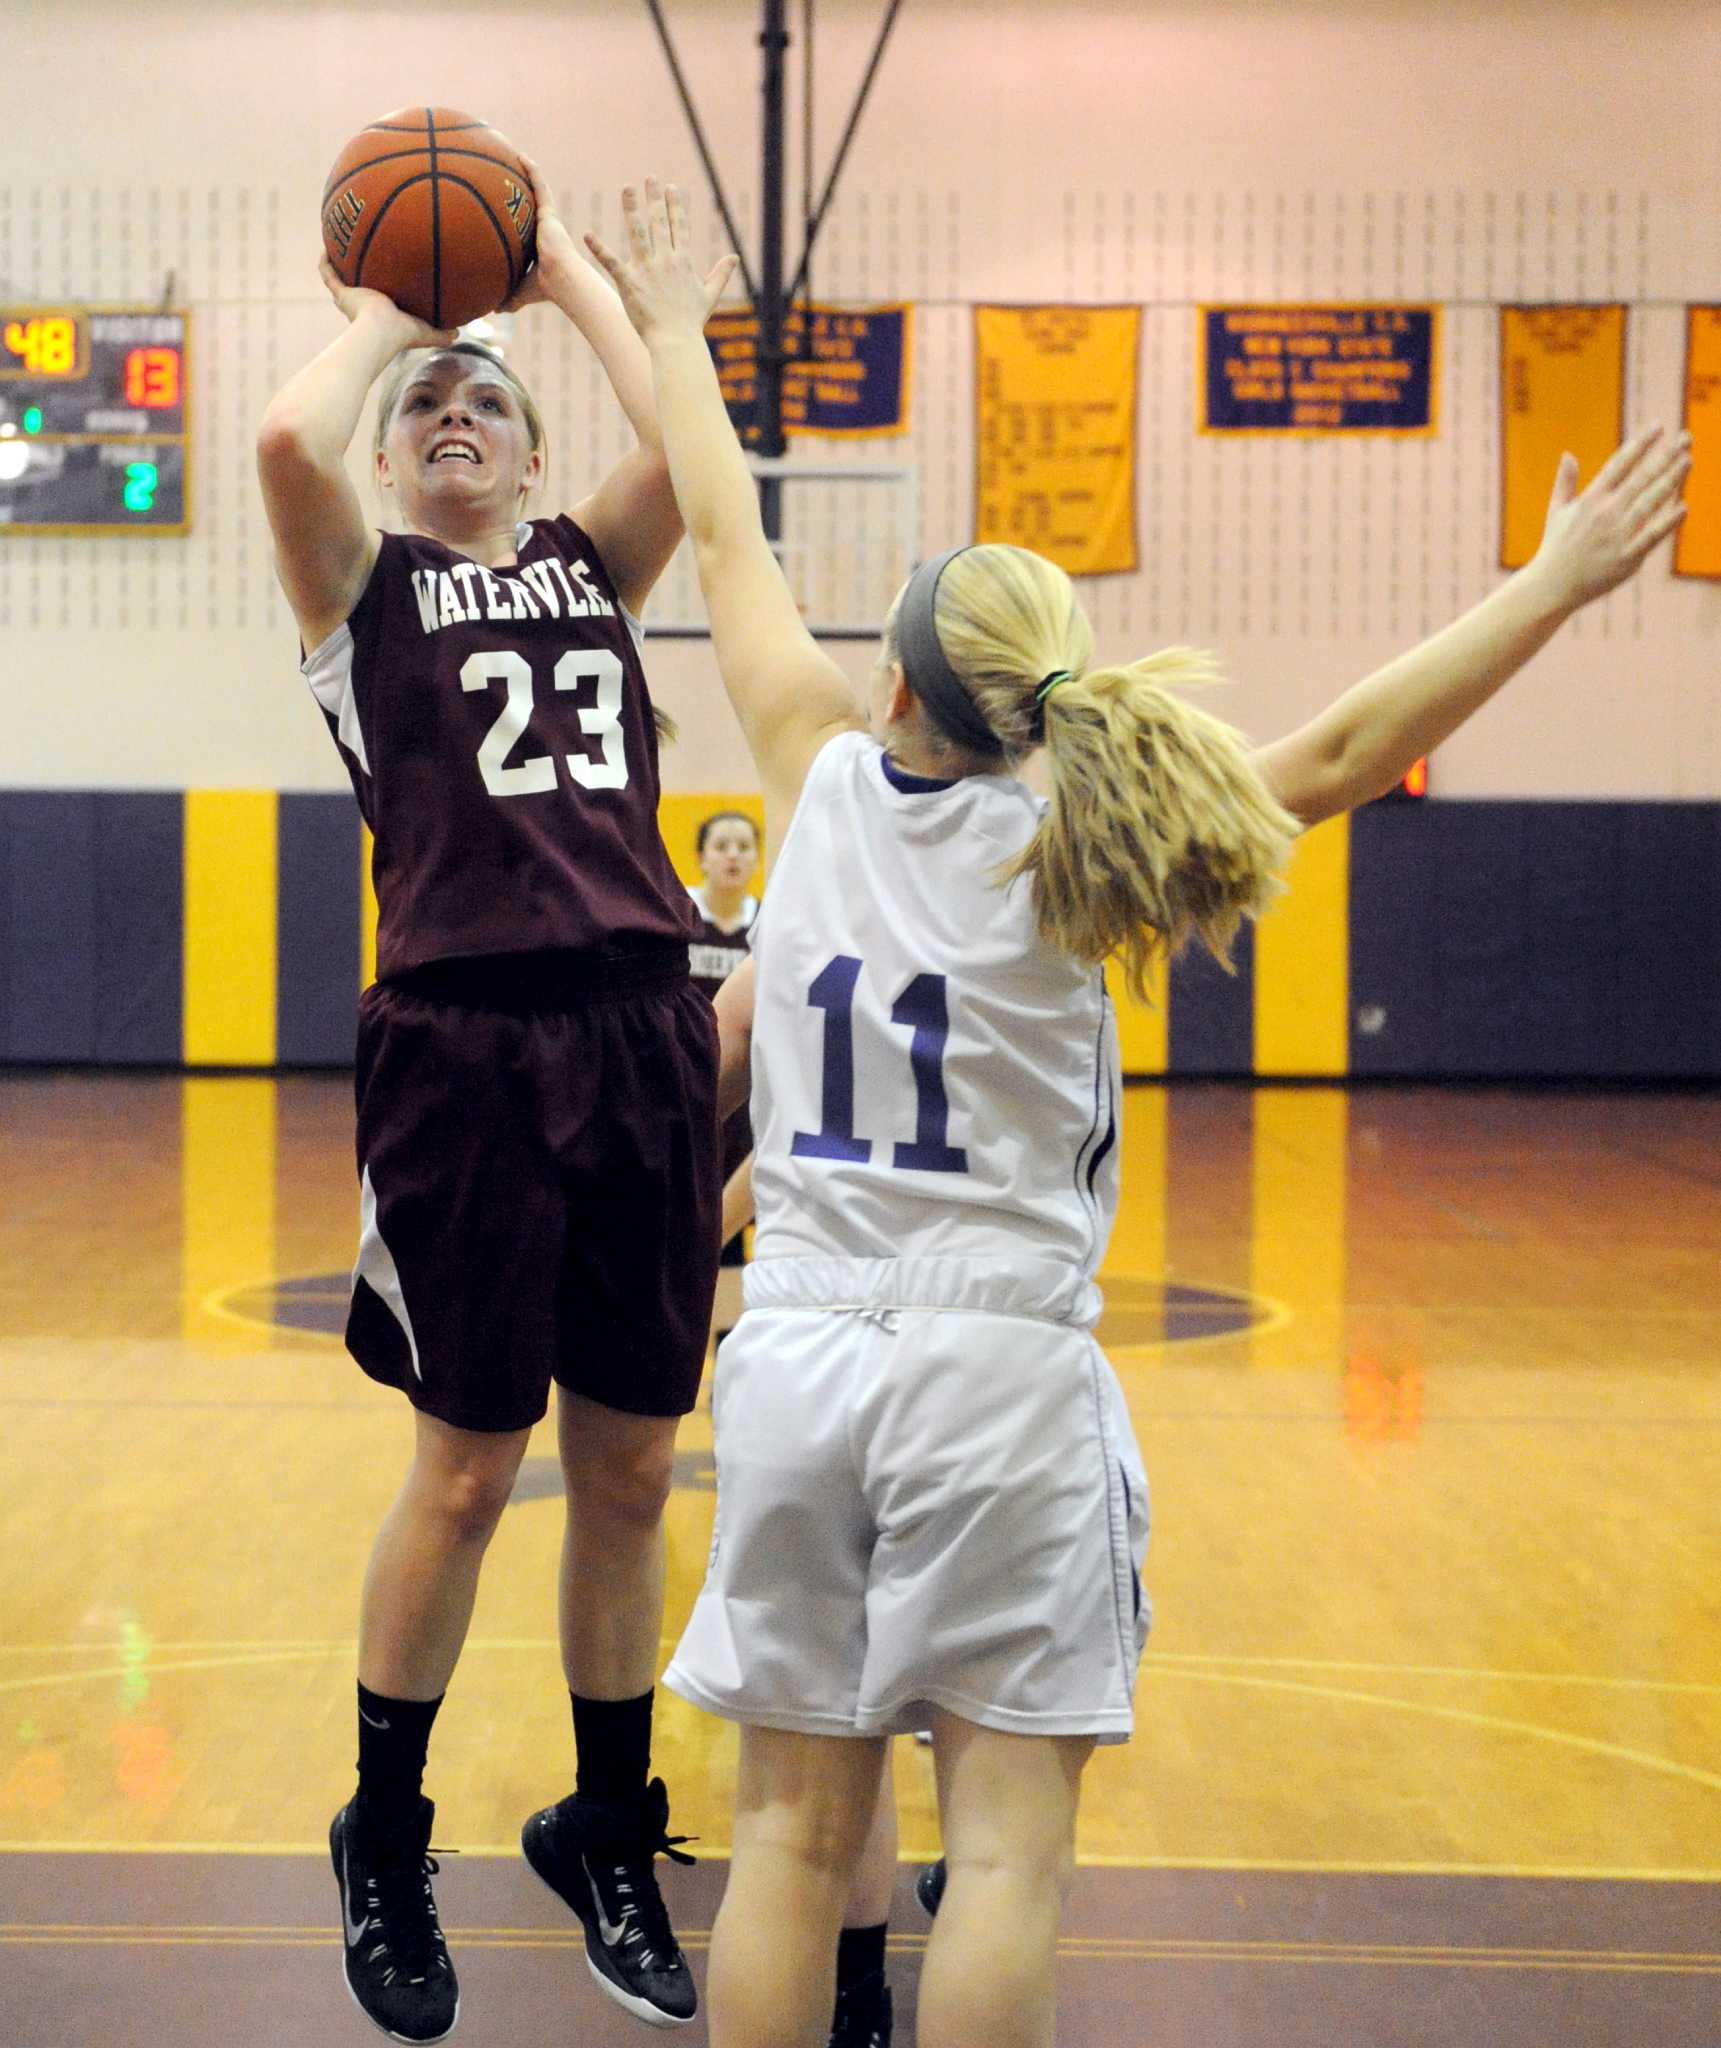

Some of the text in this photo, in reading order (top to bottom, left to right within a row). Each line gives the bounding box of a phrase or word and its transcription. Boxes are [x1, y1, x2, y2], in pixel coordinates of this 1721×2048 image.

[4, 317, 76, 374] 48
[124, 346, 181, 410] 13
[123, 462, 158, 512] 2
[459, 649, 629, 796] 23
[790, 955, 969, 1173] 11
